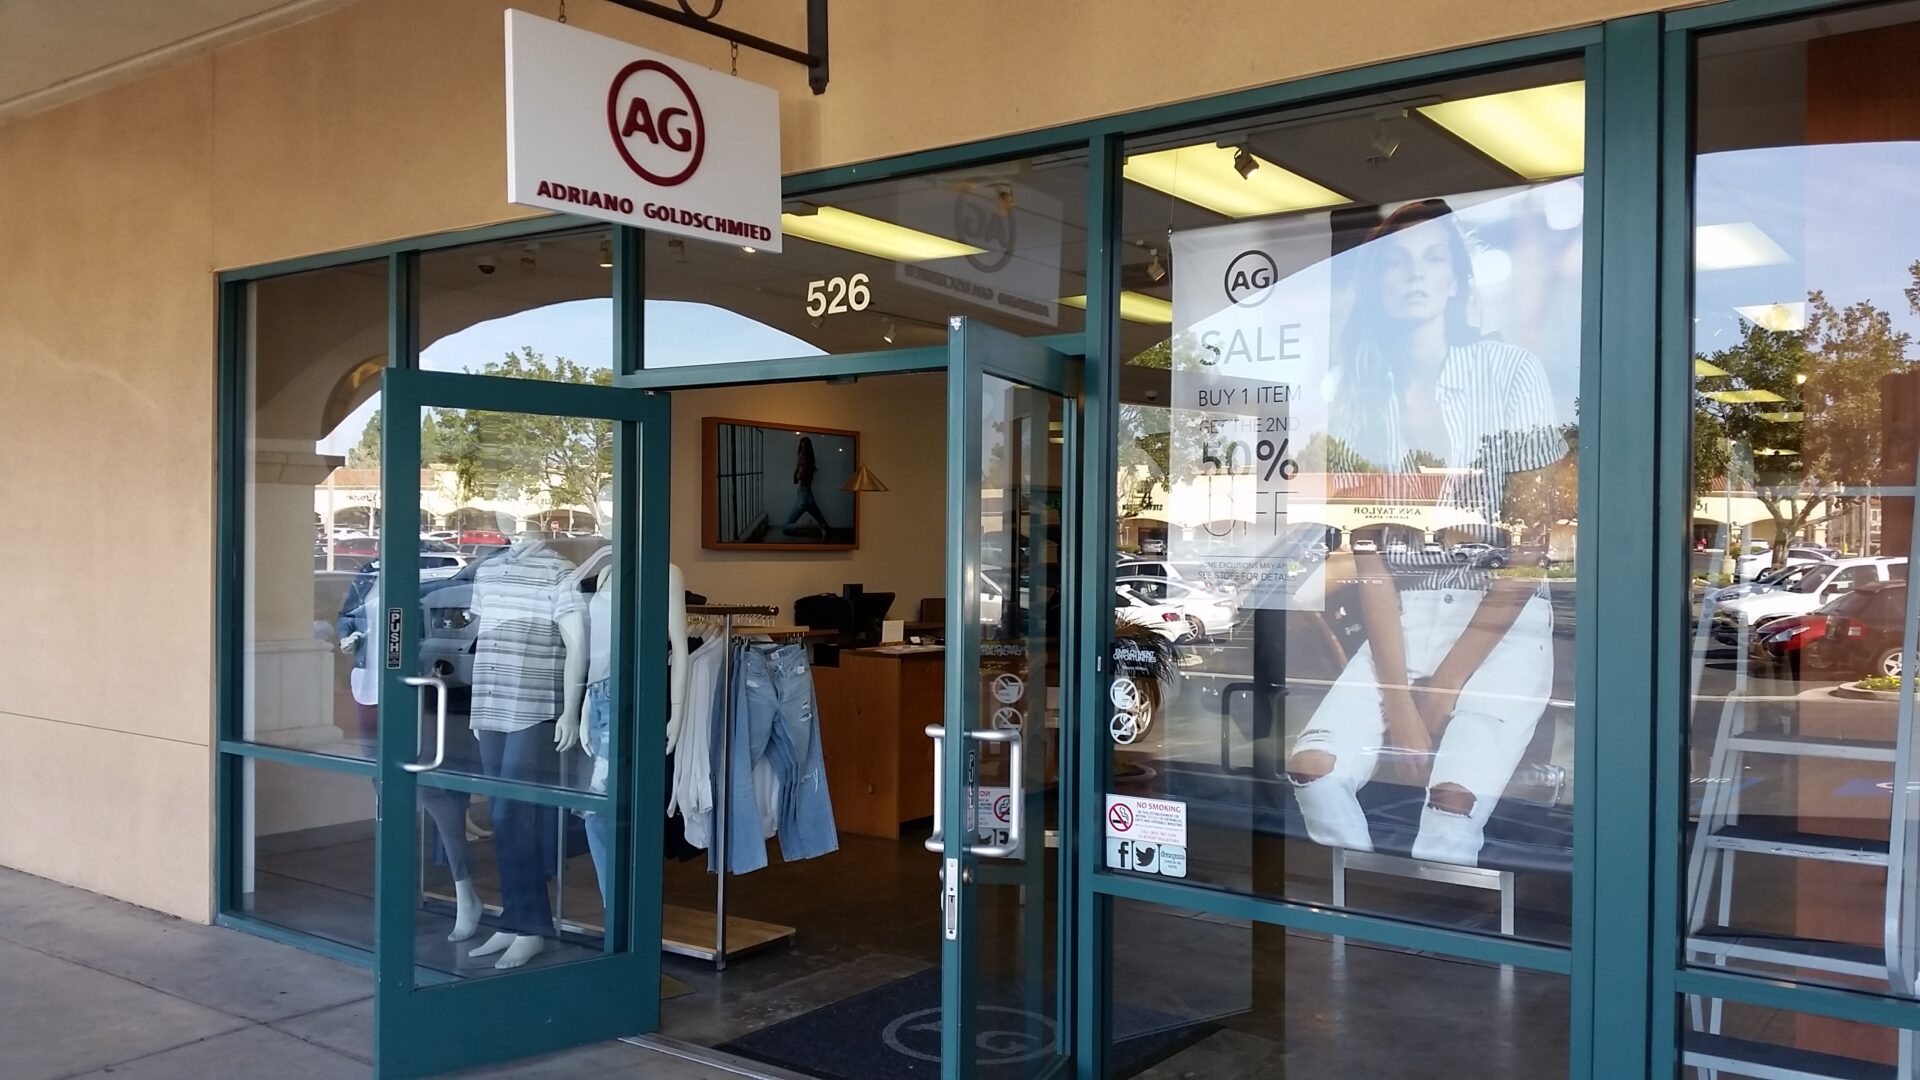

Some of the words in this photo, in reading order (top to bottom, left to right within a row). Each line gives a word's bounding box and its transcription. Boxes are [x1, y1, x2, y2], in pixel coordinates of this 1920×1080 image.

[621, 96, 692, 152] AG
[536, 180, 634, 215] ADRIANO
[643, 202, 772, 242] GOLDSCHMIED
[806, 272, 871, 318] 526
[1231, 267, 1270, 292] AG
[1199, 322, 1302, 366] SALE
[1198, 387, 1236, 407] BUY
[1241, 387, 1249, 405] 1
[1257, 384, 1302, 404] ITEM
[1231, 416, 1263, 433] THE
[1266, 415, 1300, 433] 2ND
[1202, 437, 1299, 482] 50%
[1241, 572, 1259, 581] FOR
[1260, 562, 1275, 570] MAY
[390, 613, 401, 652] PUSH
[1136, 801, 1147, 809] NO
[1148, 802, 1181, 813] SMOKING
